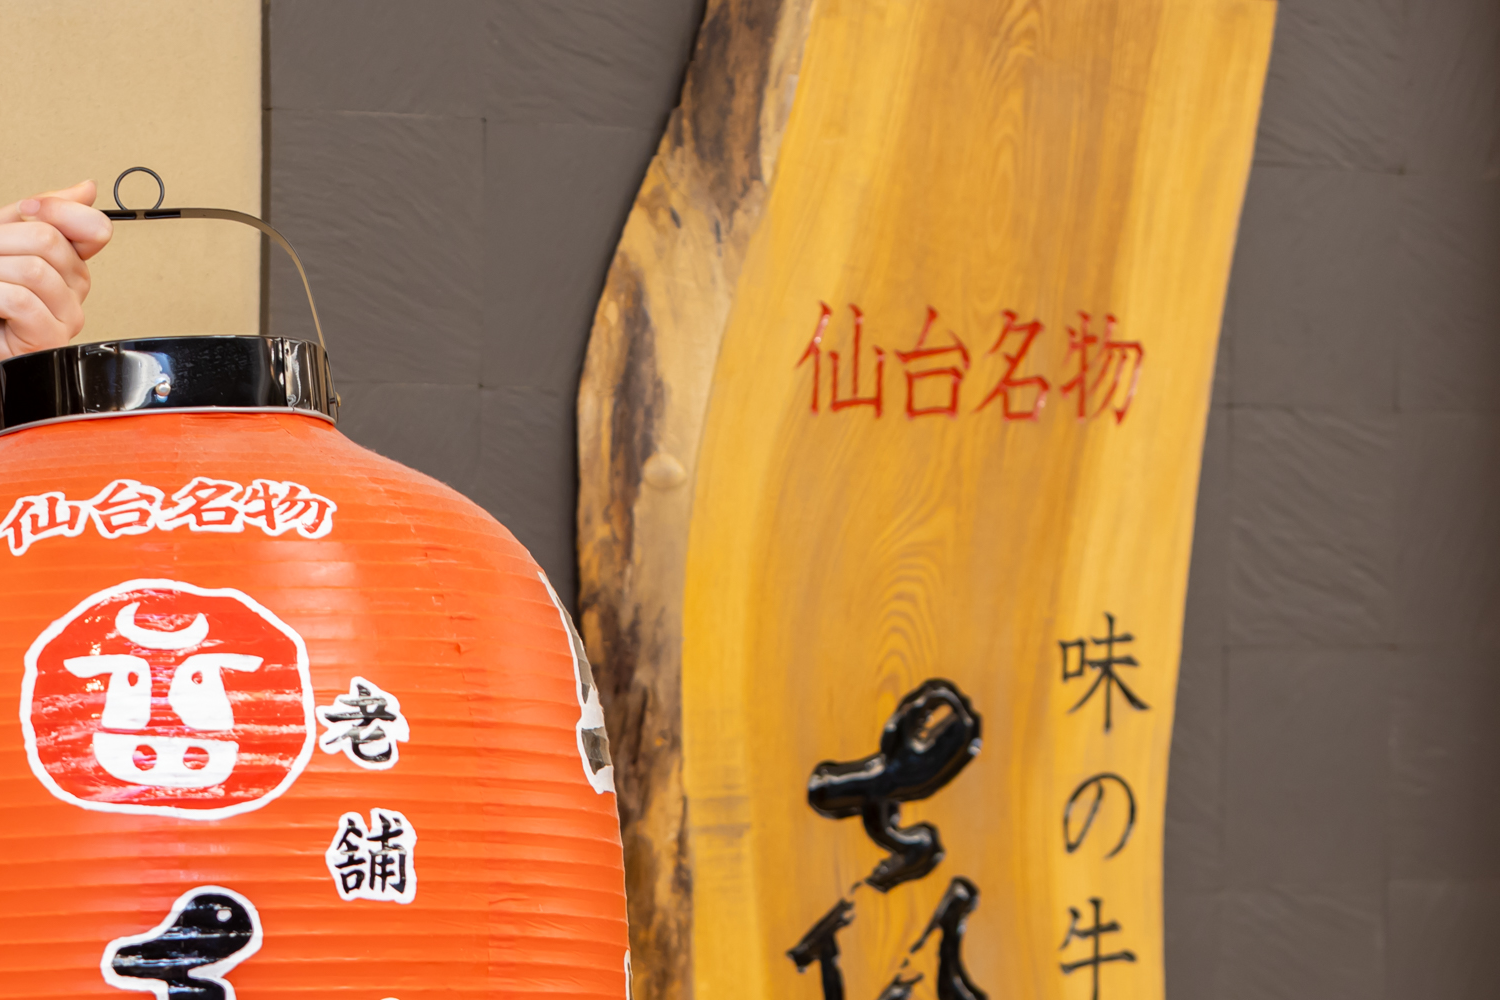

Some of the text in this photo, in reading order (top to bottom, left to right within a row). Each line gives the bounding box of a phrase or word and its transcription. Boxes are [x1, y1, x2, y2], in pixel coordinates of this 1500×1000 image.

[795, 300, 1145, 425] 仙台名物
[317, 677, 416, 903] 老舗
